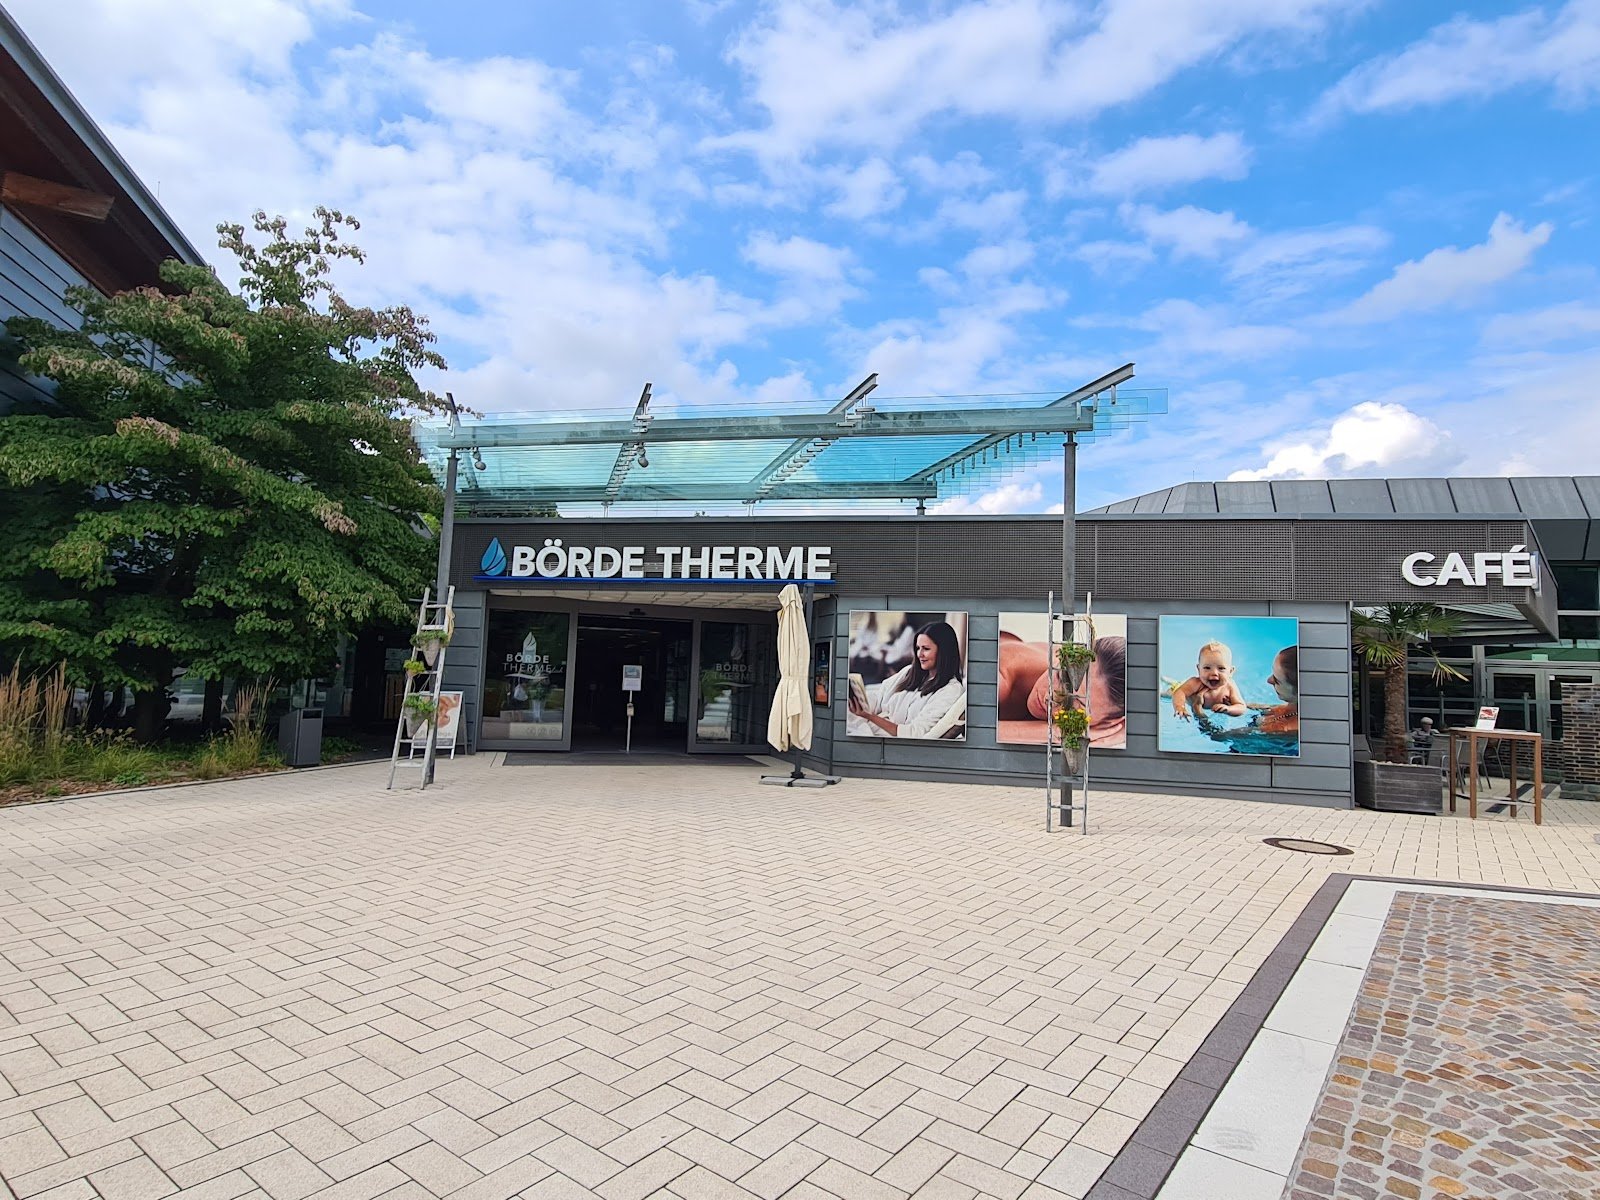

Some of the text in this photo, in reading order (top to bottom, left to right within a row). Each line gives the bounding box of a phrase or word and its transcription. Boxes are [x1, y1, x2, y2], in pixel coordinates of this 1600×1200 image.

[511, 538, 832, 580] BÖRDE THERME
[1401, 544, 1536, 587] CAFÉ
[502, 663, 551, 673] THERME
[506, 652, 549, 663] BÖRDE
